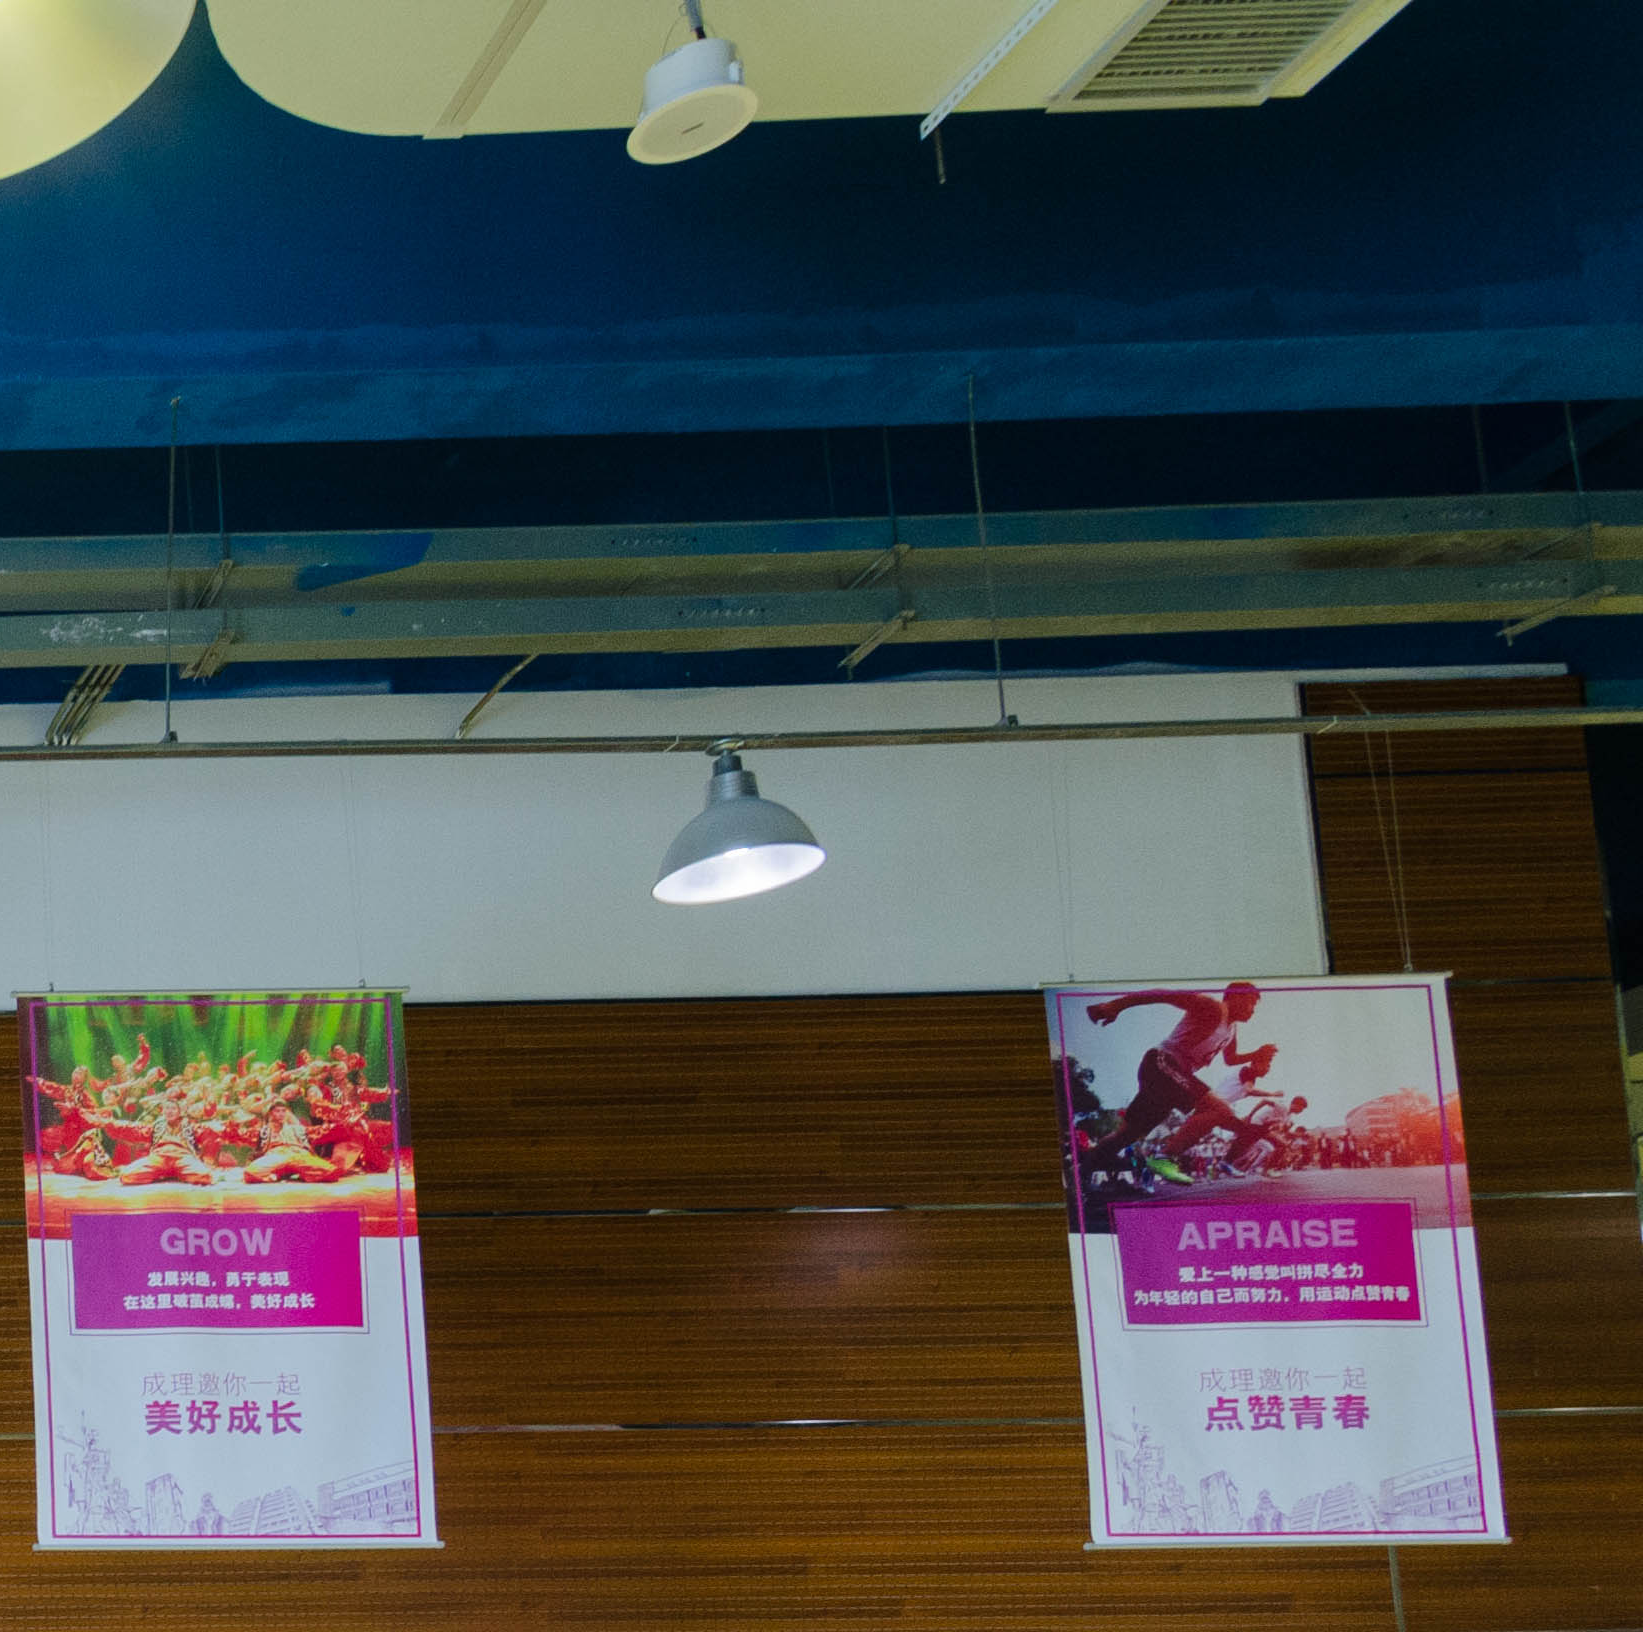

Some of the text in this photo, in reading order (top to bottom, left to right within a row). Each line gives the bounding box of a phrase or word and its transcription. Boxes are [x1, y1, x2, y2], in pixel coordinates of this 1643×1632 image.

[160, 1227, 274, 1256] GROW
[1177, 1218, 1358, 1251] APRAISE
[141, 1372, 302, 1397] 成理邀你一起
[1198, 1367, 1368, 1393] 成理邀你一起
[144, 1400, 304, 1435] 美好成长
[1204, 1394, 1371, 1433] 点赞青春
